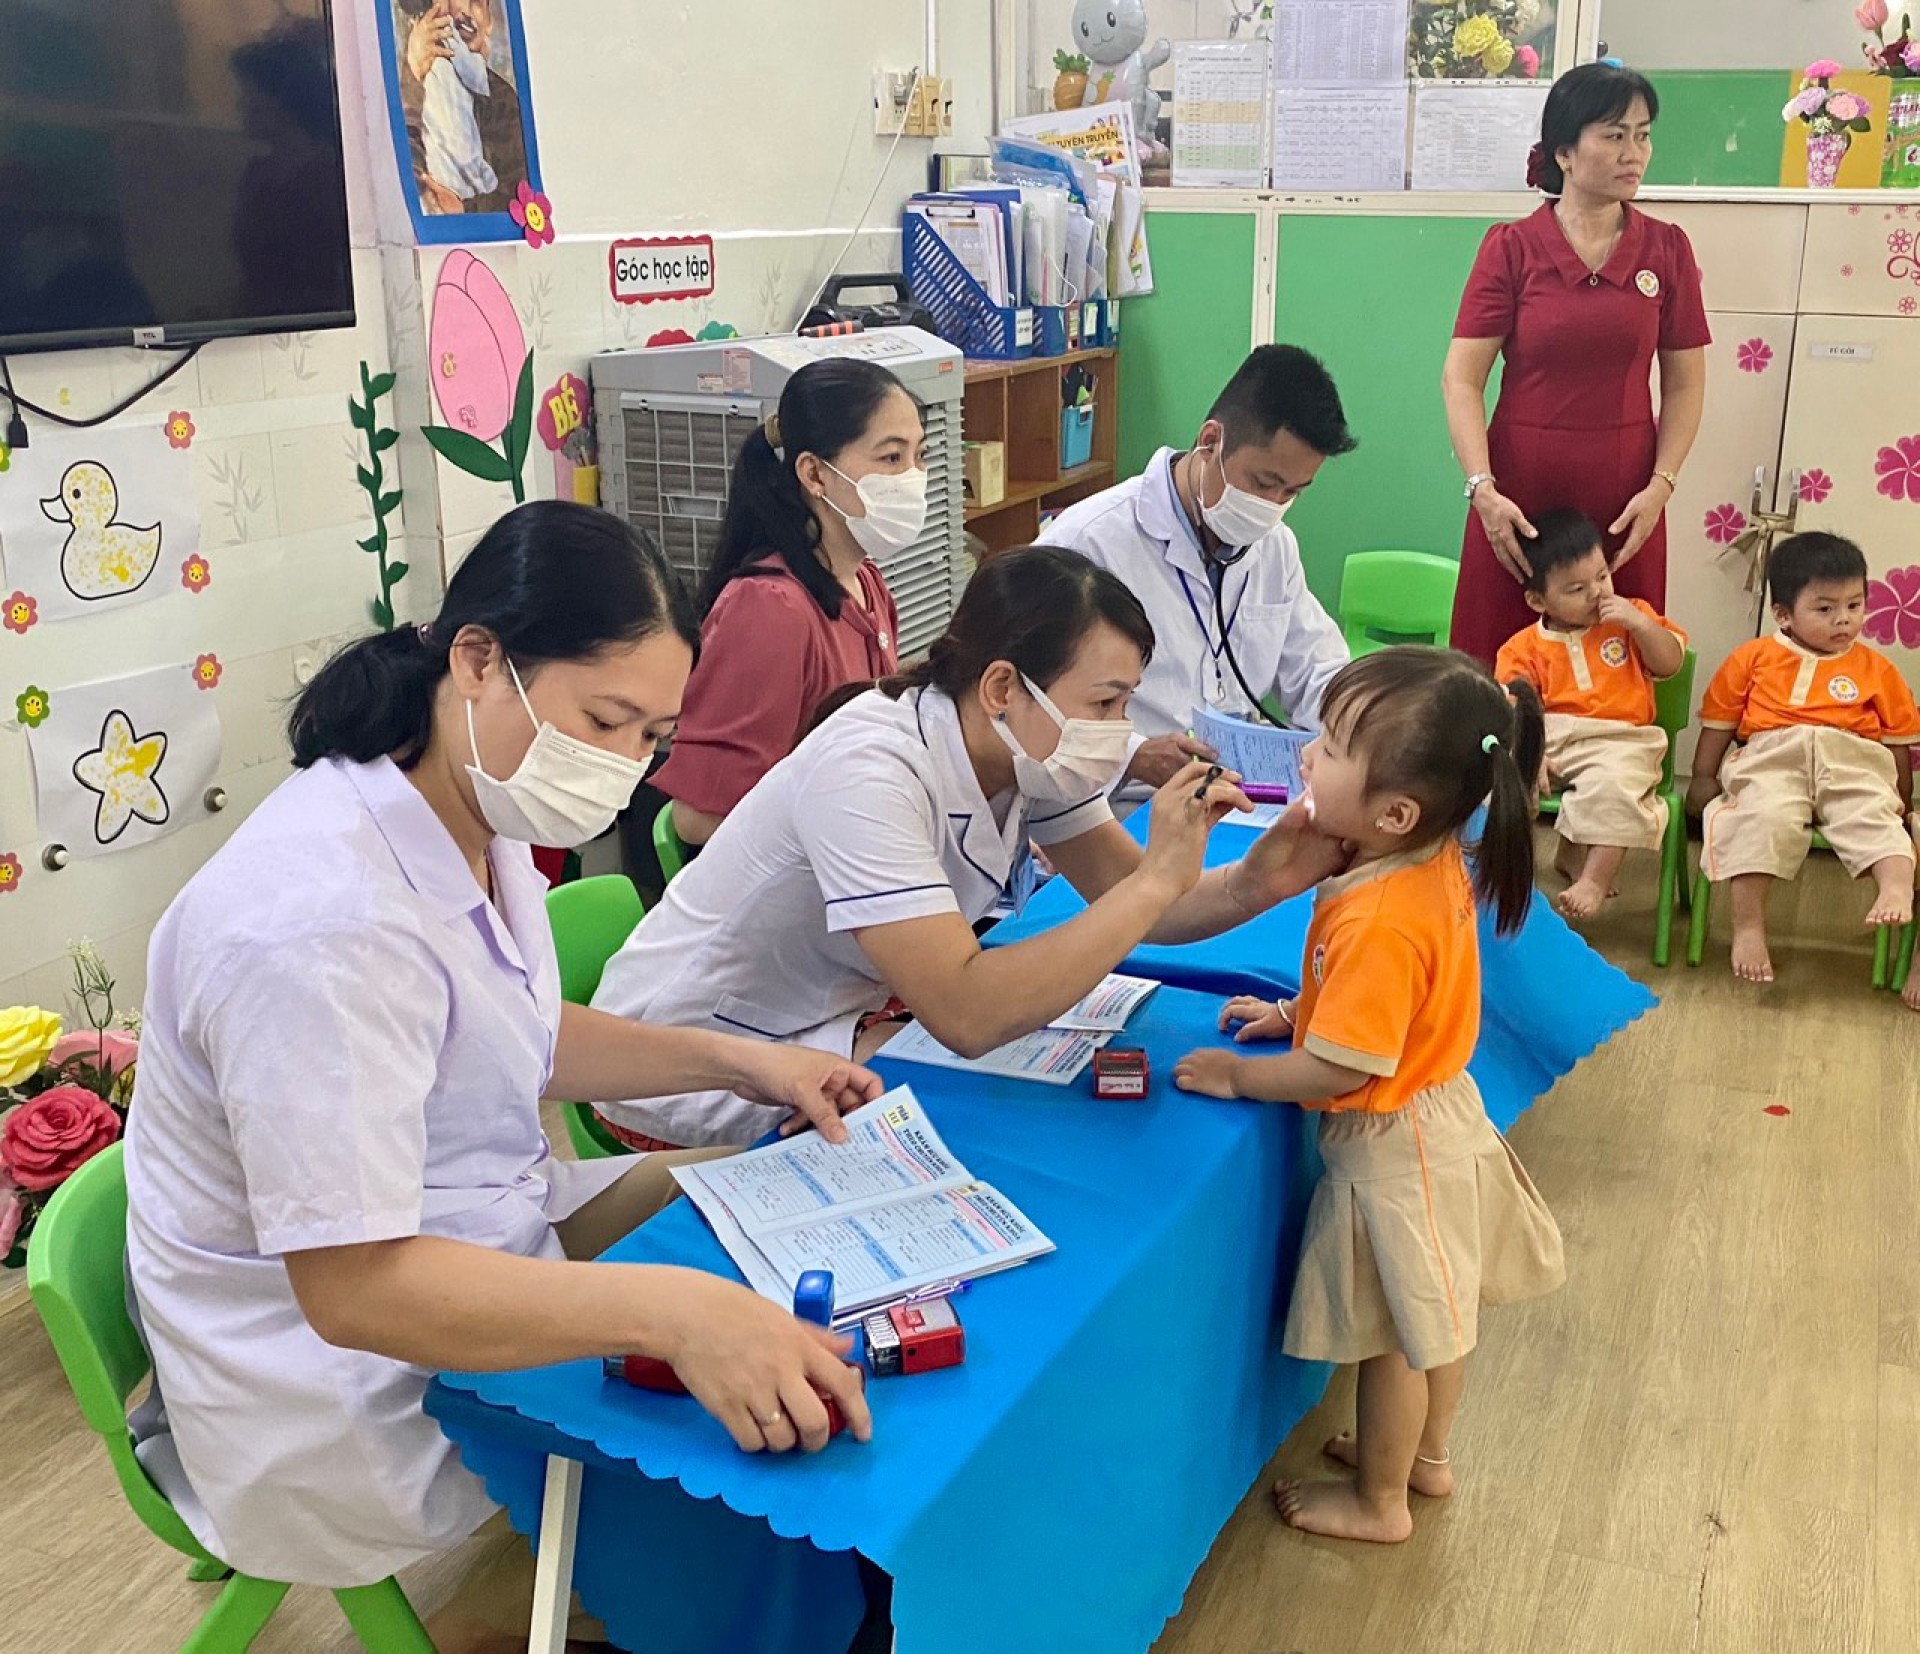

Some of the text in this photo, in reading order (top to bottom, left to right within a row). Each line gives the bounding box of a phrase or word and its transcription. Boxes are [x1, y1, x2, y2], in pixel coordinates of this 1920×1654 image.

[616, 254, 709, 285] Góc học tập
[548, 374, 583, 439] BÉ
